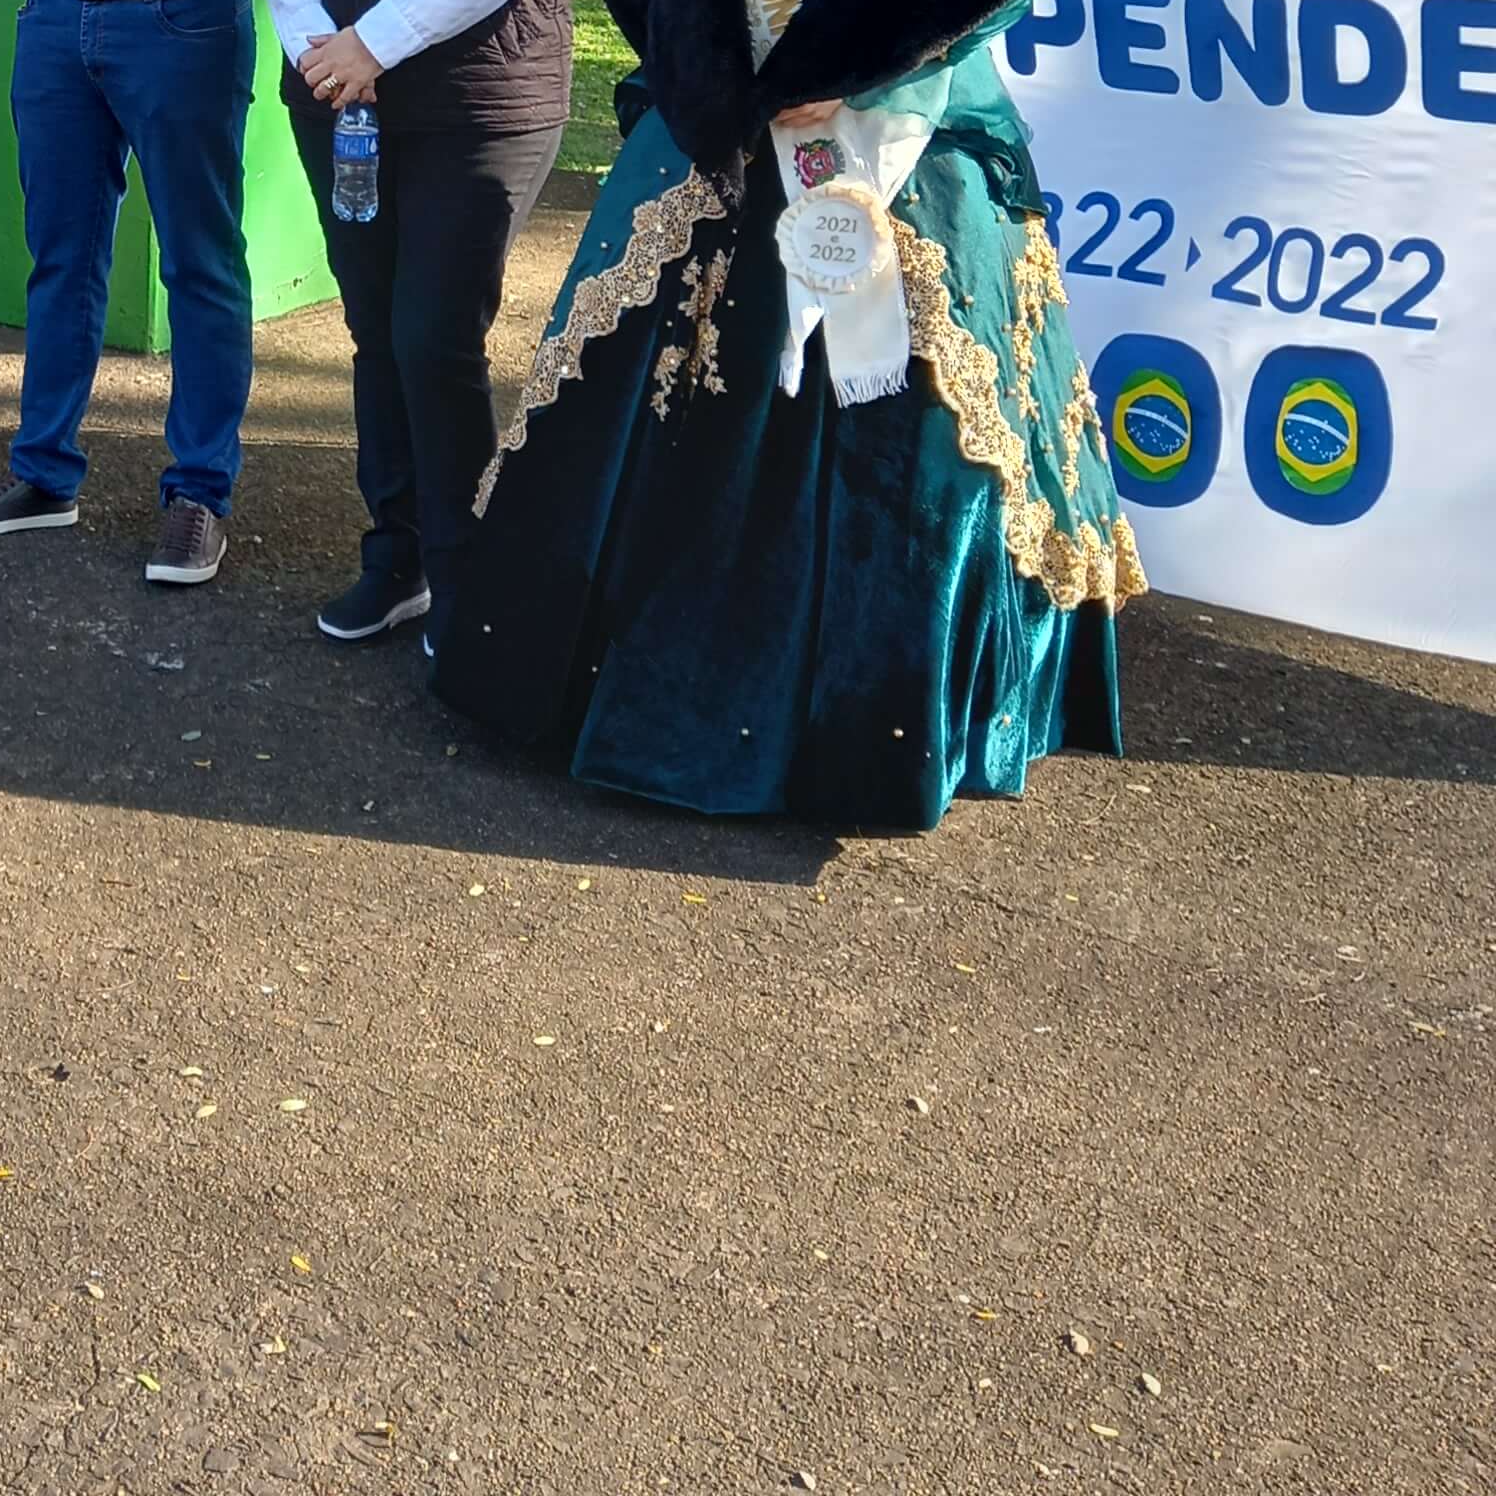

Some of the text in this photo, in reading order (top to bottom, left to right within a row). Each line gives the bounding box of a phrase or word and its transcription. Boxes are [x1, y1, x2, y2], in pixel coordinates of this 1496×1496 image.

[815, 215, 858, 234] 2021
[810, 243, 857, 263] 2022
[1212, 215, 1446, 331] 2022
